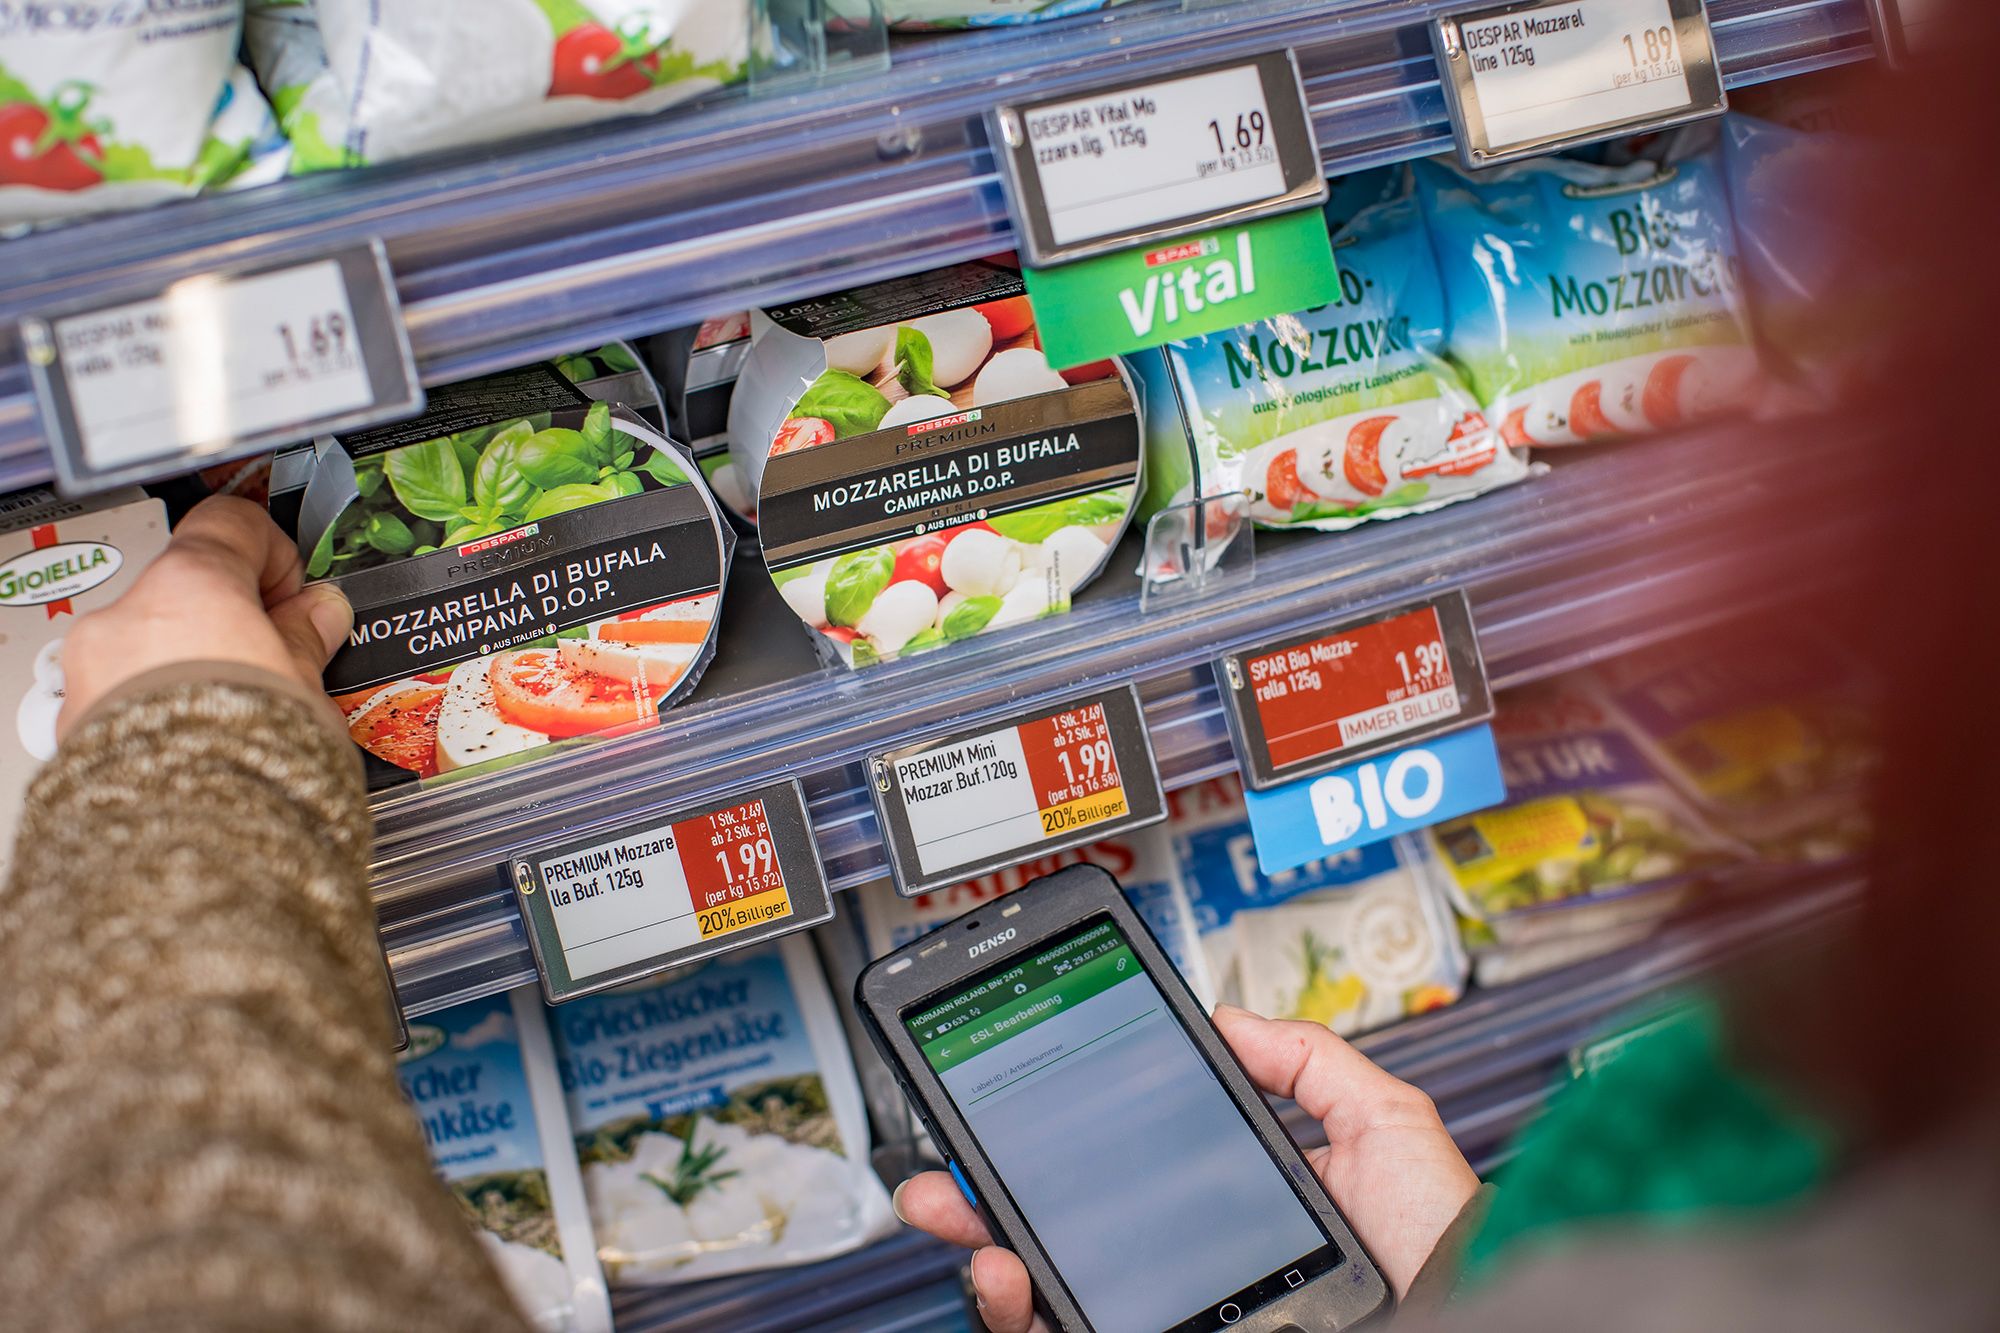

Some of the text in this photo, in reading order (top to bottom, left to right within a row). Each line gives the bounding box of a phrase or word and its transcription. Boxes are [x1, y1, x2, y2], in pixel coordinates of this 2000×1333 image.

[1467, 8, 1585, 50] DESPAR Mozzarel
[1621, 25, 1673, 68] 1.89
[1472, 44, 1535, 74] line 125g
[1612, 59, 1681, 89] (per kg 15.12)
[1031, 96, 1157, 139] DESPAR Vital Mo
[1208, 110, 1265, 153] 1.69
[1109, 124, 1147, 149] 125g
[1156, 240, 1201, 265] SPAR
[1118, 231, 1255, 338] Vital
[917, 413, 968, 433] DESPAR
[1253, 399, 1278, 415] aus
[896, 422, 996, 456] PREMIUM
[812, 433, 1081, 513] MOZZARELLA DI BUFALA
[884, 471, 1015, 515] CAMPANA D.O.P.
[927, 511, 977, 532] AUS ITALIEN
[447, 535, 557, 579] PREMIUM
[471, 529, 526, 553] DESPAR
[349, 542, 667, 647] MOZZARELLA DI BUFALA
[408, 580, 616, 655] CAMPANA D.O.P.
[493, 627, 545, 651] AUS ITALIEN
[1250, 640, 1359, 681] SPAR Bio Mozza-
[1395, 641, 1445, 683] 1.39
[1256, 669, 1322, 702] rella 125g
[1052, 705, 1101, 731] 1 Stk. 2.49
[1053, 722, 1106, 748] ab 2 Stk. je
[1343, 692, 1455, 741] IMMER BILLIG
[899, 740, 997, 783] PREMIUM Mini
[1058, 740, 1111, 784] 1.99
[1048, 772, 1119, 806] (per kg 16.58)
[1309, 748, 1445, 846] BIO
[709, 803, 762, 829] 1 Stk. 2.49
[710, 820, 768, 847] ab 2 Stk. je
[544, 837, 674, 884] PREMIUM Mozzare
[715, 838, 773, 885] 1.99
[550, 868, 644, 907] lla Buf. 125g
[705, 871, 782, 907] (per kg 15.92)
[967, 926, 1018, 959] DENSO
[1072, 938, 1119, 966] 29.07. 15:51
[912, 967, 1024, 1028] HÖRMANN ROLAND, BNr 2479
[952, 1013, 970, 1027] 63%
[970, 992, 1063, 1045] ESL Bearbeitung
[1009, 1042, 1065, 1076] Artikelnummer
